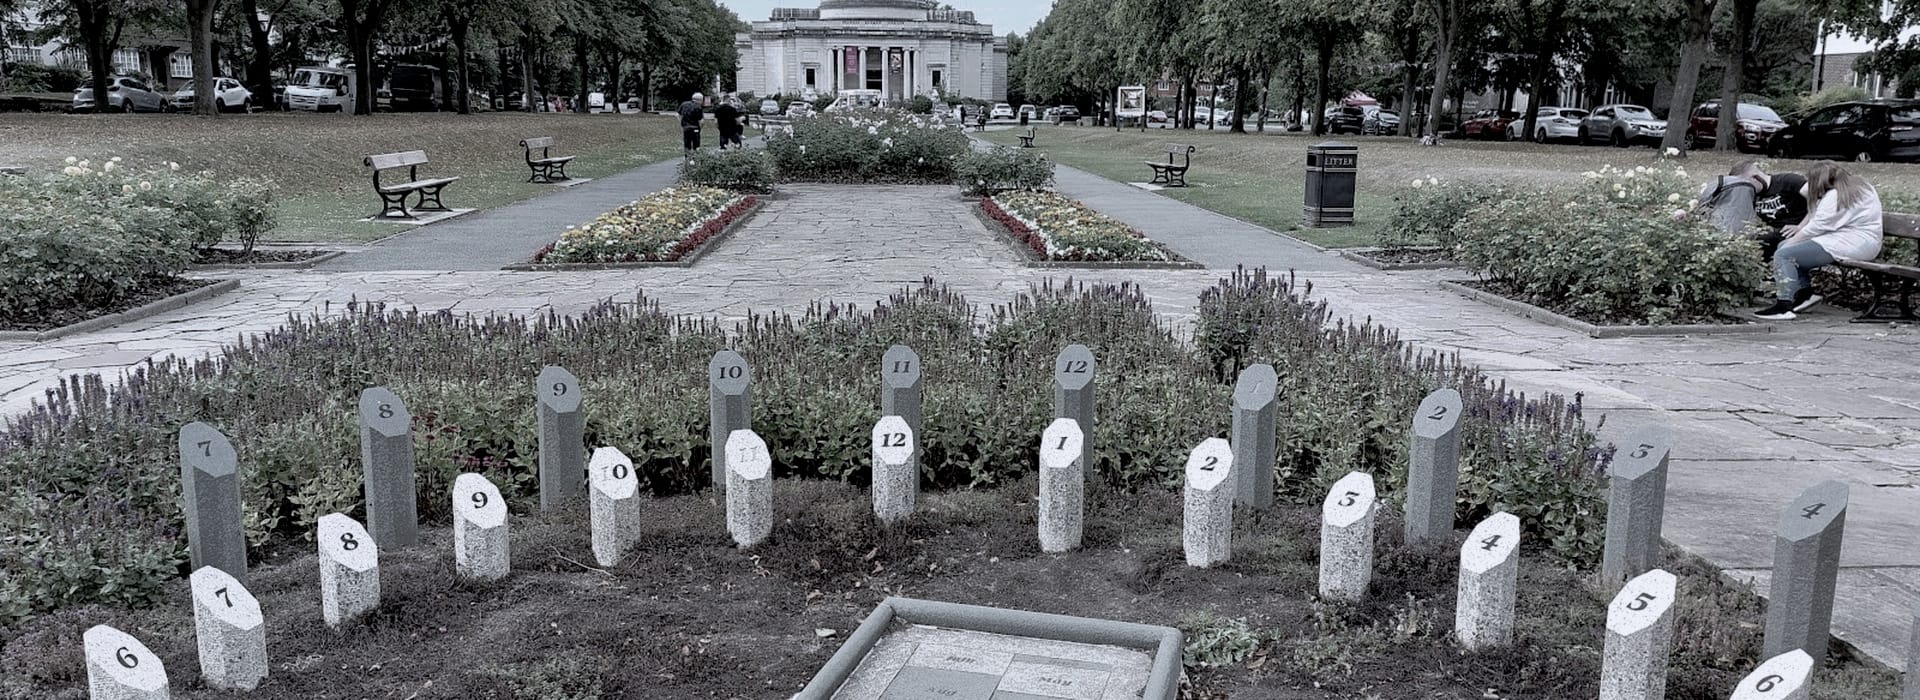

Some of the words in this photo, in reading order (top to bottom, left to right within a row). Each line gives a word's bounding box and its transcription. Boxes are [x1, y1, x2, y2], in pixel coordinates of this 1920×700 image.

[1324, 157, 1353, 166] LITTER
[719, 365, 742, 379] 10
[892, 360, 910, 373] 11
[1064, 360, 1088, 373] 12
[552, 382, 567, 396] 9
[379, 403, 394, 419] 8
[1427, 405, 1448, 420] 2
[882, 432, 906, 448] 12
[1056, 436, 1068, 450] 1
[197, 440, 211, 457] 7
[601, 463, 628, 480] 10
[1199, 456, 1218, 471] 2
[471, 491, 488, 509] 9
[1800, 502, 1826, 519] 4
[340, 532, 359, 551] 8
[1480, 534, 1502, 551] 4
[215, 586, 233, 608] 7
[1626, 592, 1656, 611] 5
[115, 646, 139, 669] 6
[1756, 674, 1784, 693] 6
